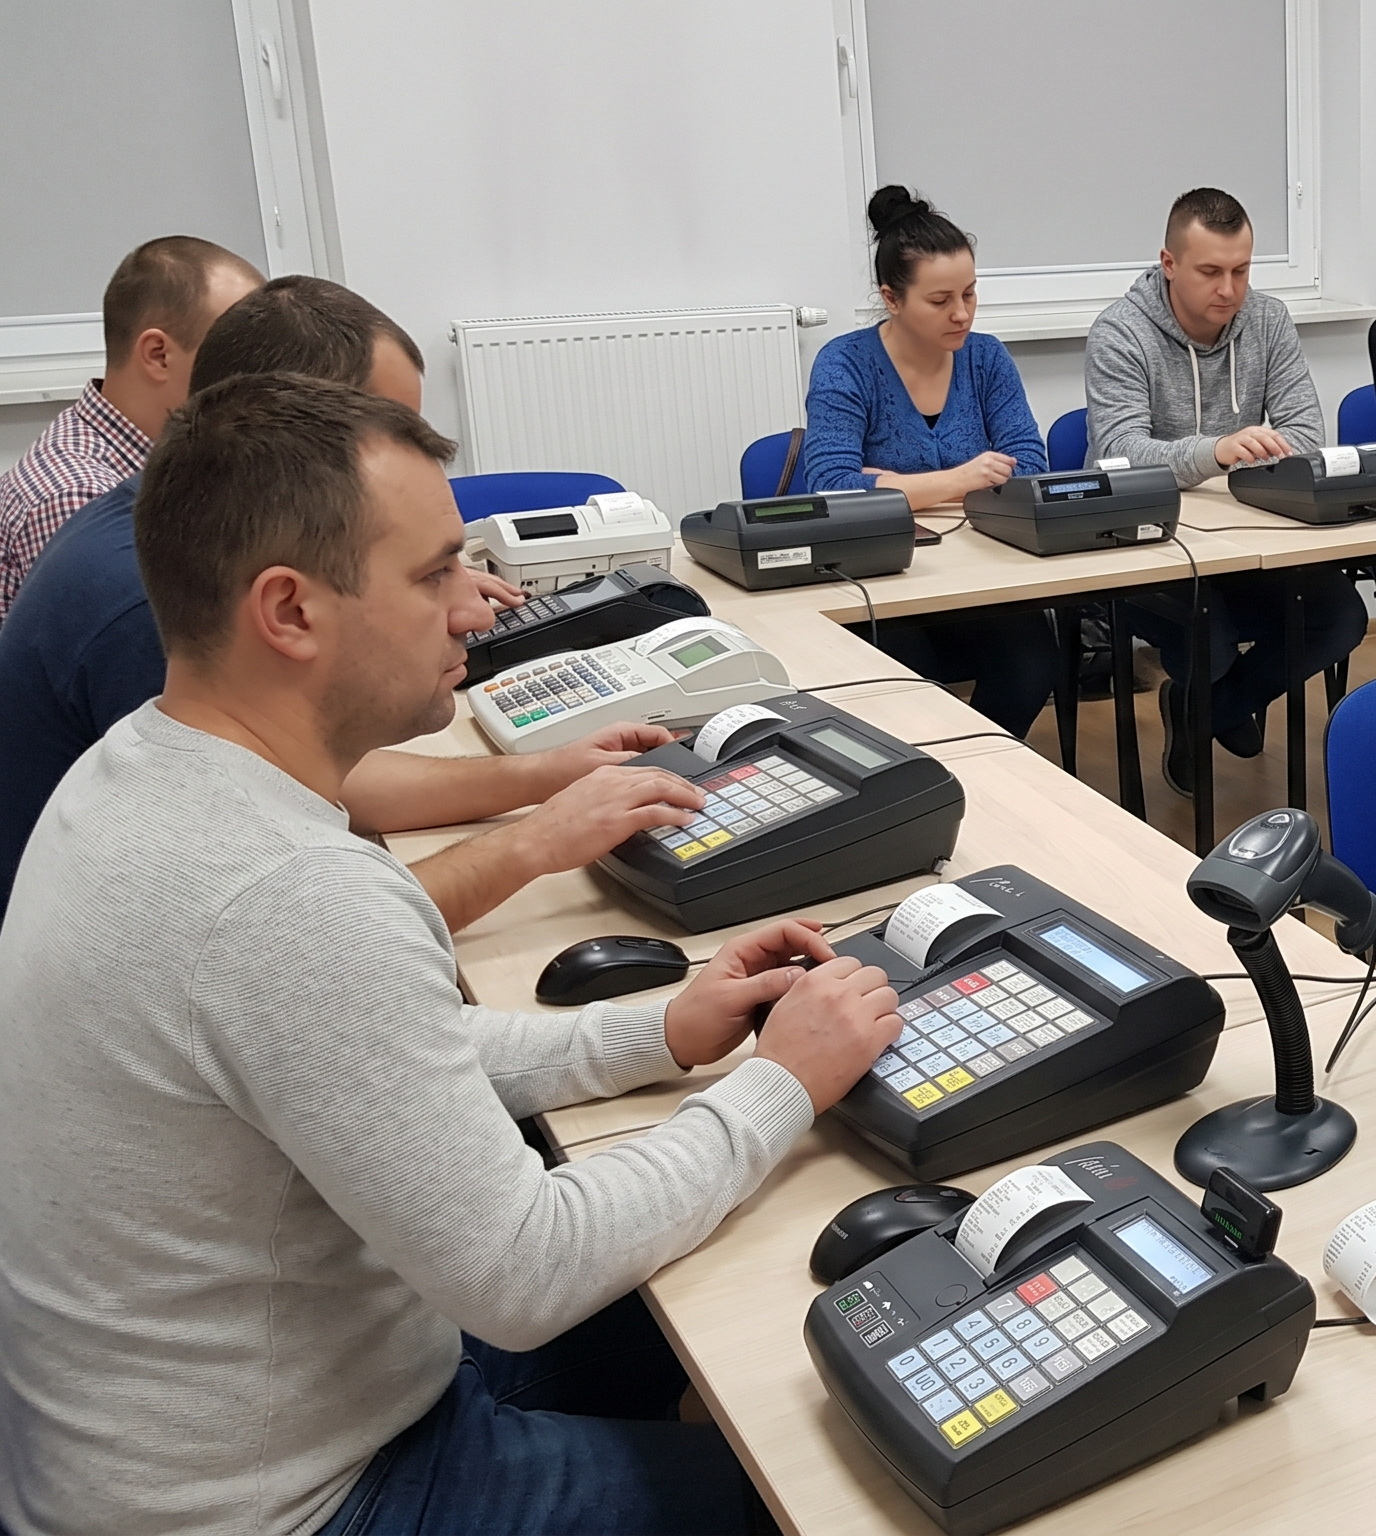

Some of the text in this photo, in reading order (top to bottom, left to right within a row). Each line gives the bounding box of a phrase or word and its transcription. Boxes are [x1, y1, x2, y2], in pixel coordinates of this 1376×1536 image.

[997, 1299, 1013, 1309] 7
[967, 1319, 983, 1329] 4
[1016, 1318, 1032, 1331] 8
[933, 1338, 949, 1347] 1
[984, 1337, 1000, 1349] 5
[1033, 1336, 1050, 1348] 9
[949, 1357, 967, 1370] 2
[1001, 1357, 1018, 1369] 6
[968, 1377, 985, 1390] 3
